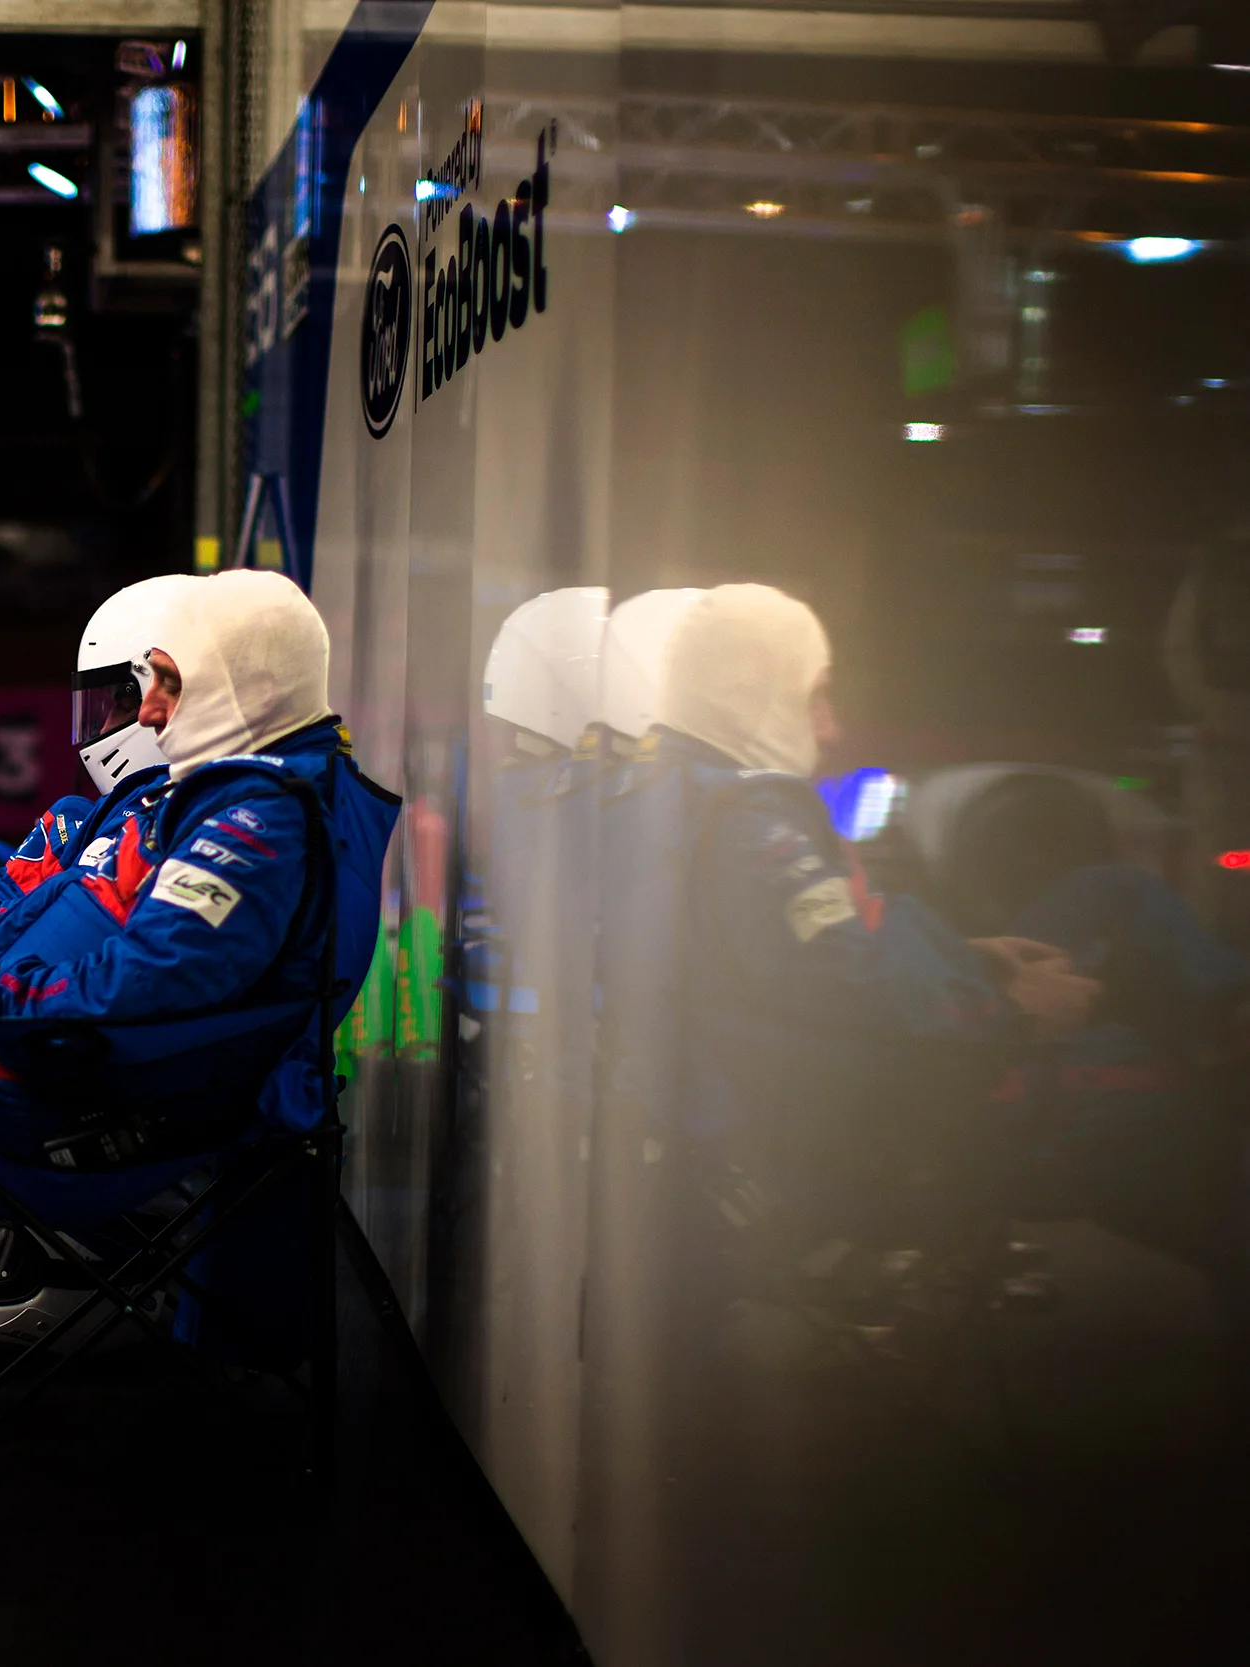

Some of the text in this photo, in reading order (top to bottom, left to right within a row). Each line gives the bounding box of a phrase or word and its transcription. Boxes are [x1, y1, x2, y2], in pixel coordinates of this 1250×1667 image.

[425, 97, 484, 242] Powered by
[422, 126, 550, 402] EcoBoost
[173, 874, 233, 907] WEC
